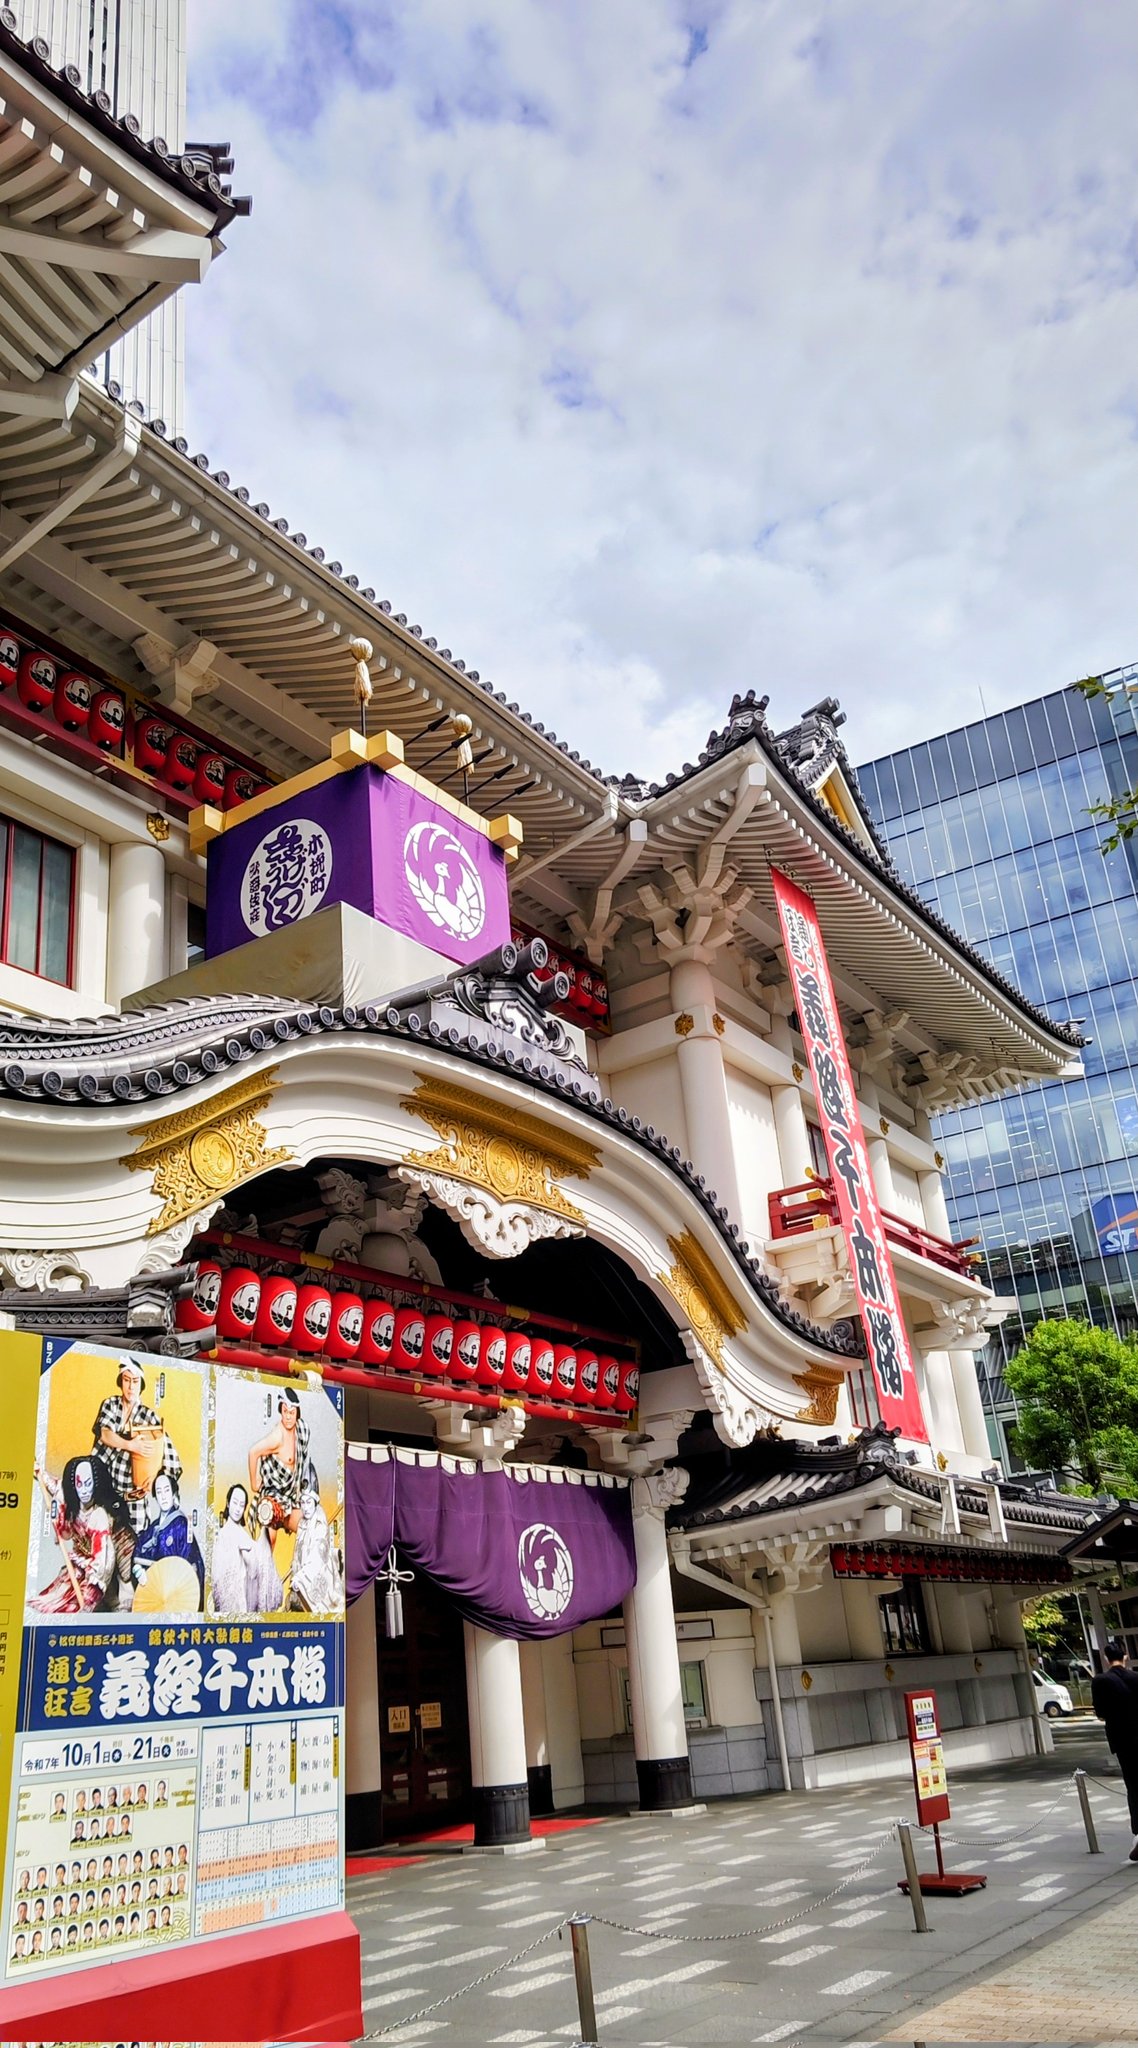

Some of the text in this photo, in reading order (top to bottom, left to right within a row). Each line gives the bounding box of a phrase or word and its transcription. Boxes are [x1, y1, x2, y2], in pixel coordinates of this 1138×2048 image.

[308, 834, 327, 896] 木挽町
[1105, 1228, 1138, 1251] ST
[99, 1644, 326, 1720] 義経千本桜
[391, 1709, 407, 1721] 入口
